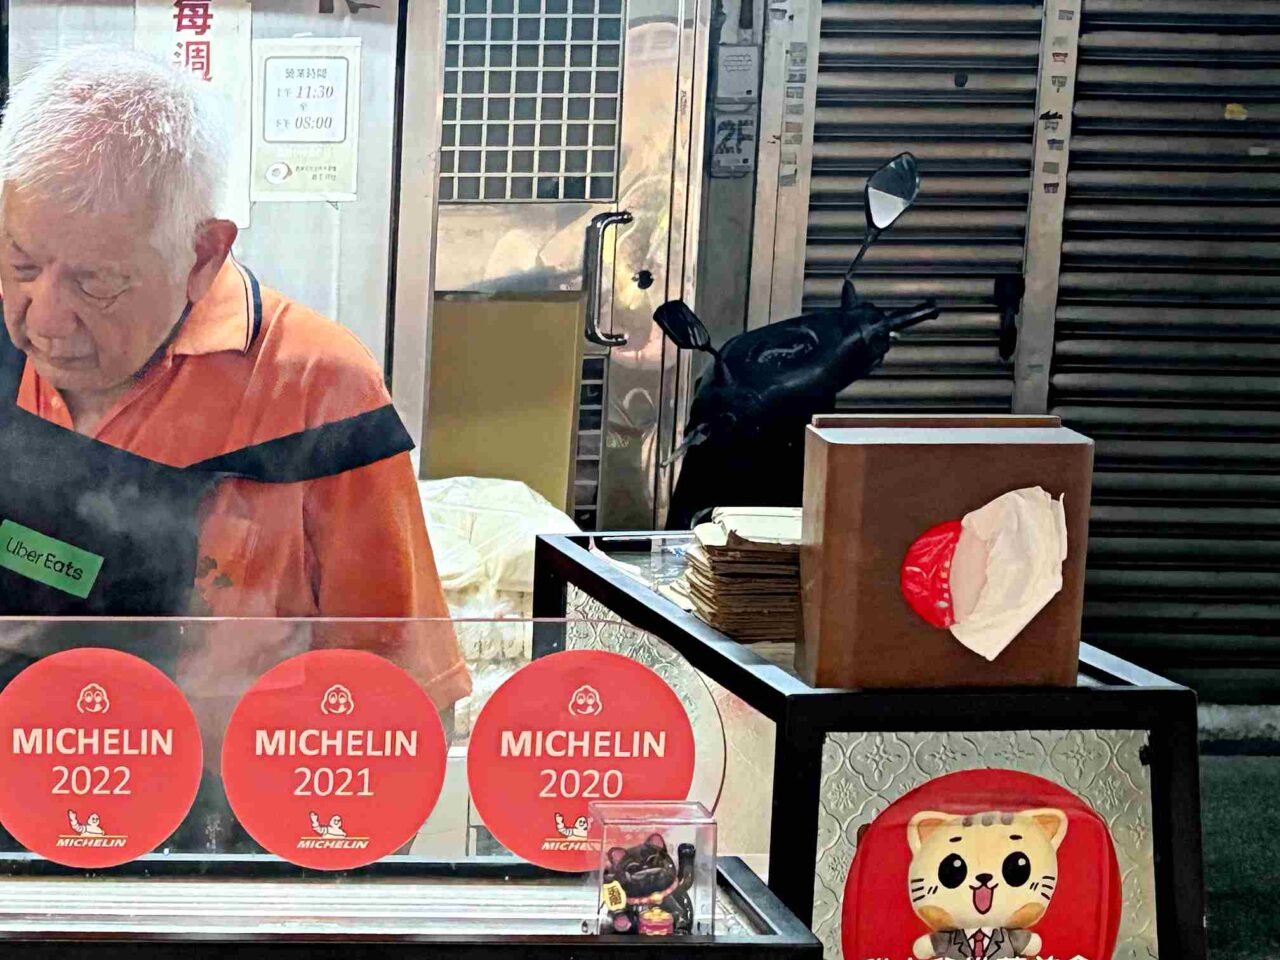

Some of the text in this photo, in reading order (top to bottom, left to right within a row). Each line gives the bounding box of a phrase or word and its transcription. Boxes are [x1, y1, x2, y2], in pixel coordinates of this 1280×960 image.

[295, 85, 334, 99] 11:30
[294, 116, 333, 130] 08:00
[5, 536, 84, 581] Uber Eats
[12, 727, 173, 755] MICHELIN
[255, 729, 418, 757] MICHELIN
[500, 730, 666, 758] MICHELIN
[51, 765, 131, 795] 2022
[293, 767, 374, 797] 2021
[538, 768, 623, 798] 2020
[56, 838, 127, 847] MICHELIN
[296, 840, 368, 849] MICHELIN
